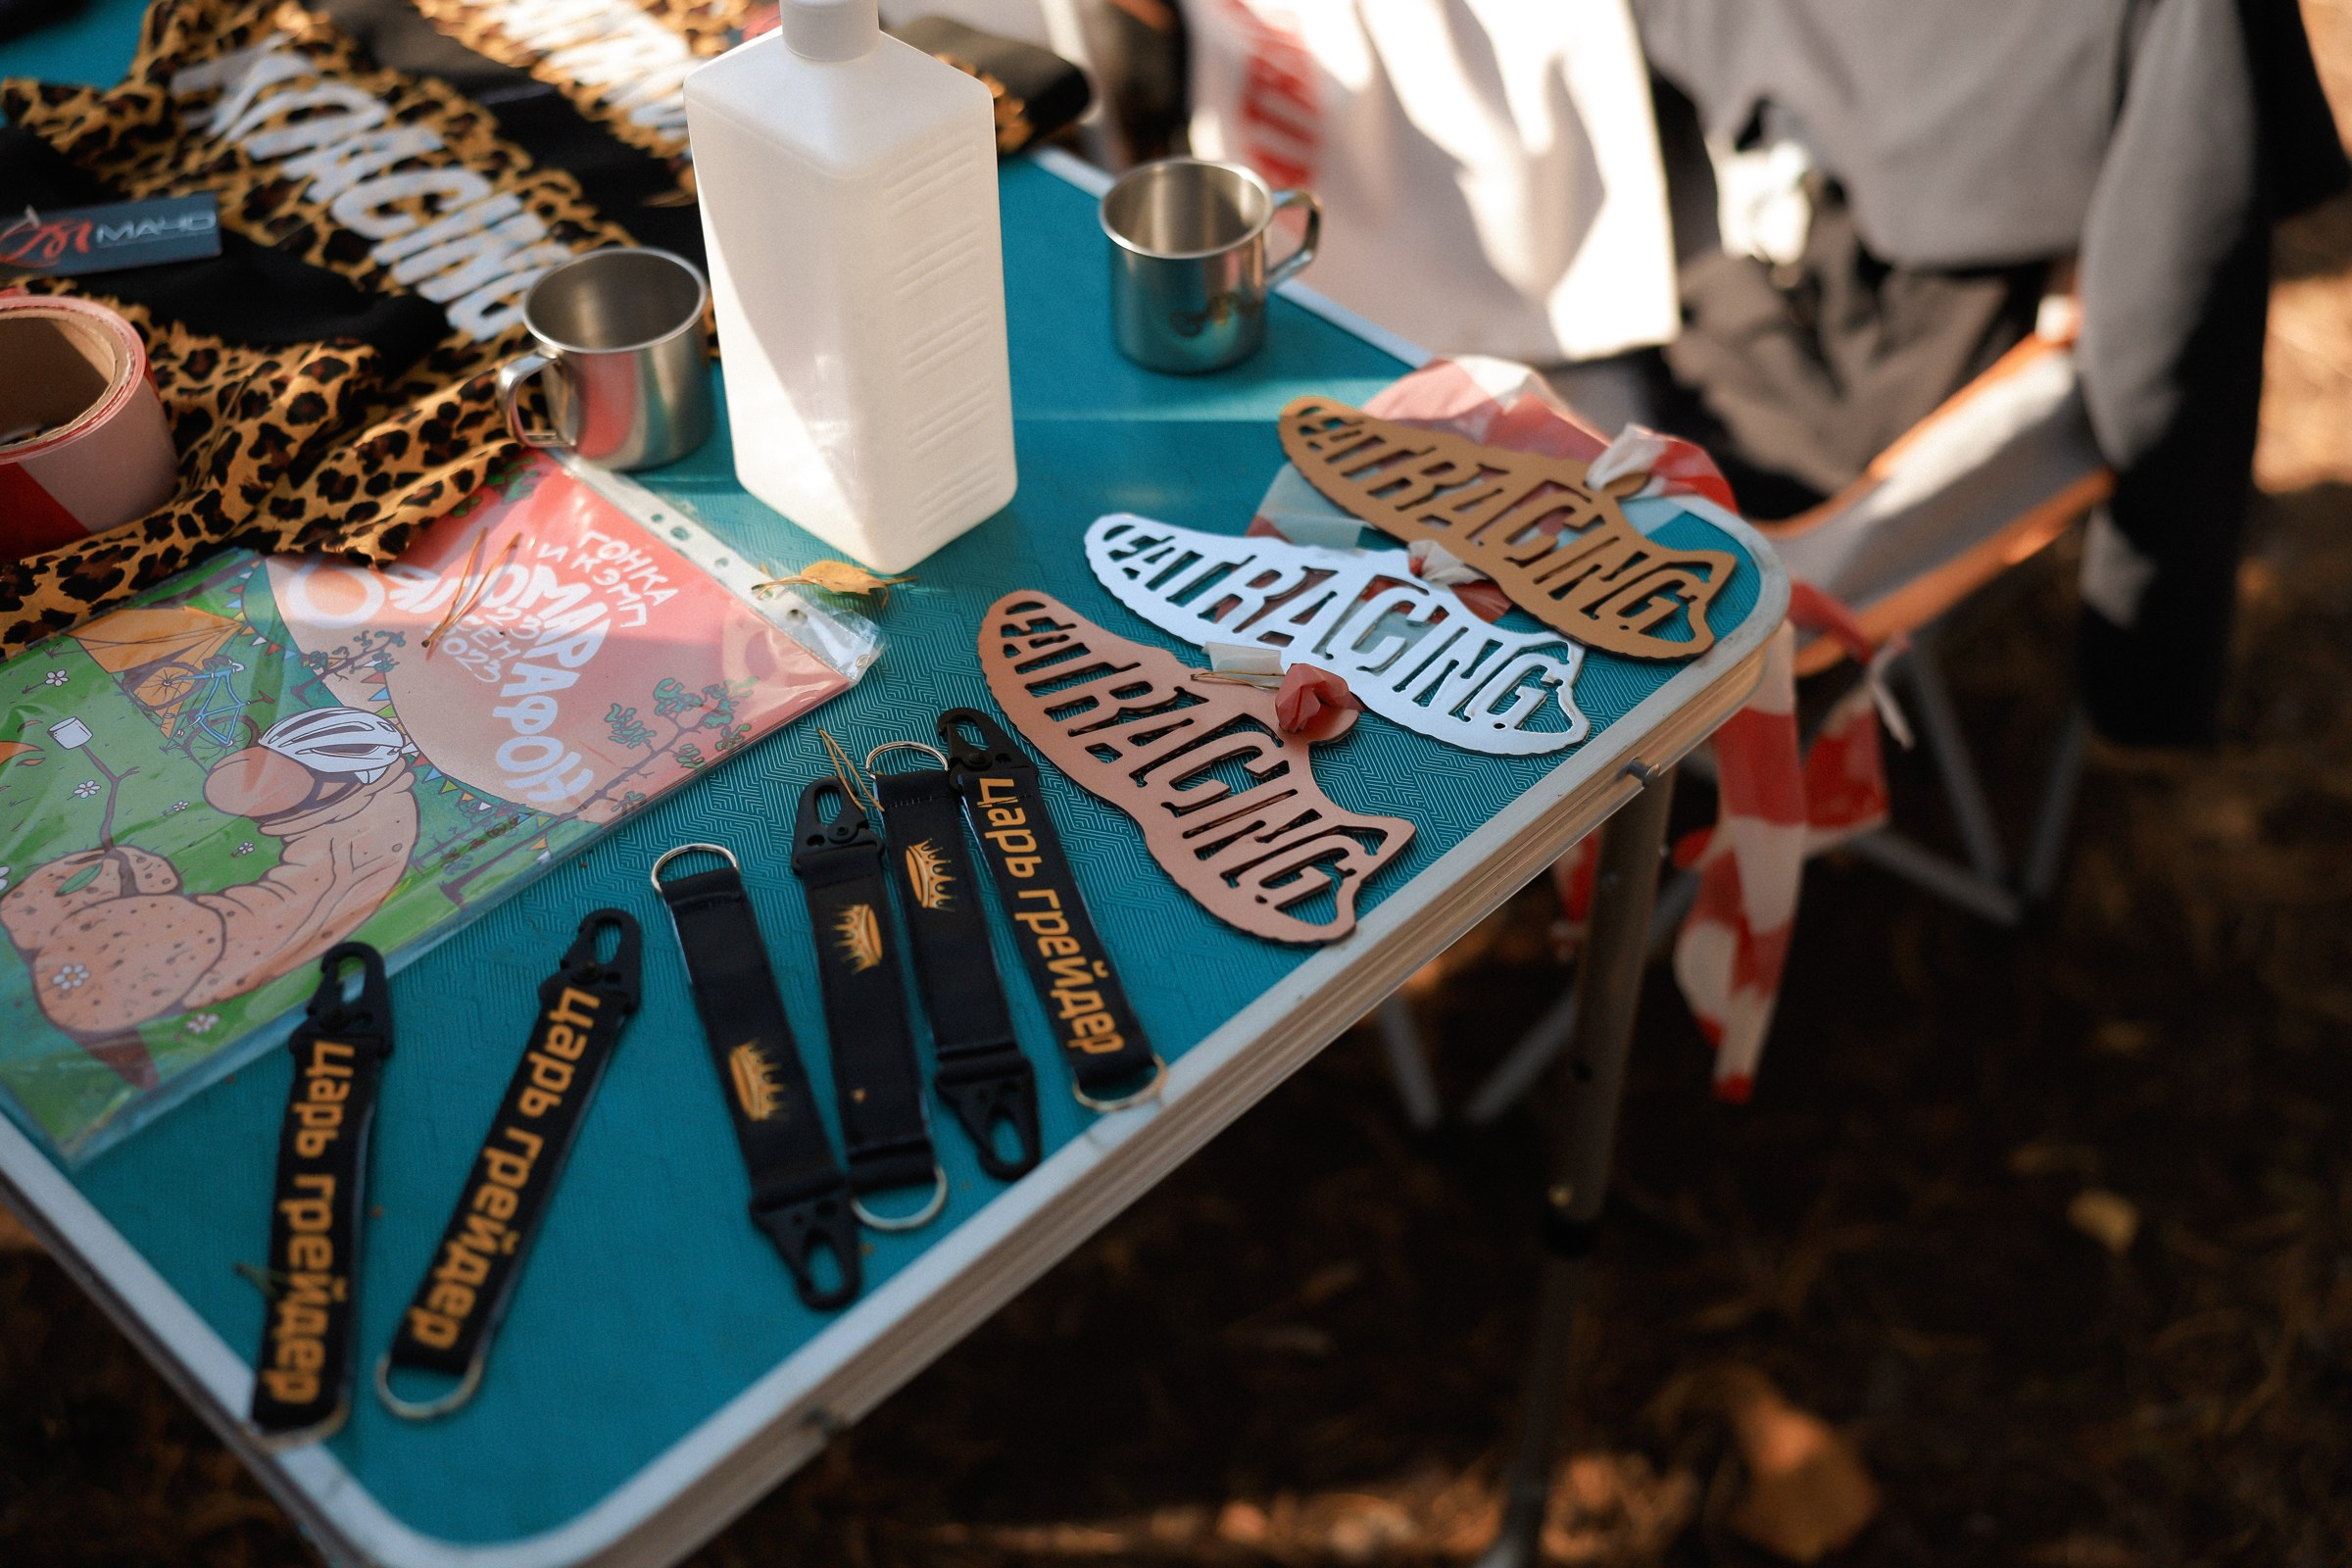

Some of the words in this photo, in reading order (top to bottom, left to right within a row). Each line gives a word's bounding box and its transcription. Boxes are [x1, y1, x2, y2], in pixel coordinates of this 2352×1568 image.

[485, 607, 541, 640] 23
[536, 542, 568, 563] И
[570, 554, 649, 628] КЭМП
[576, 530, 679, 607] ГОНКА
[1013, 889, 1125, 1054] грейдер
[265, 1174, 345, 1403] грейдер
[411, 1127, 544, 1349] грейдер
